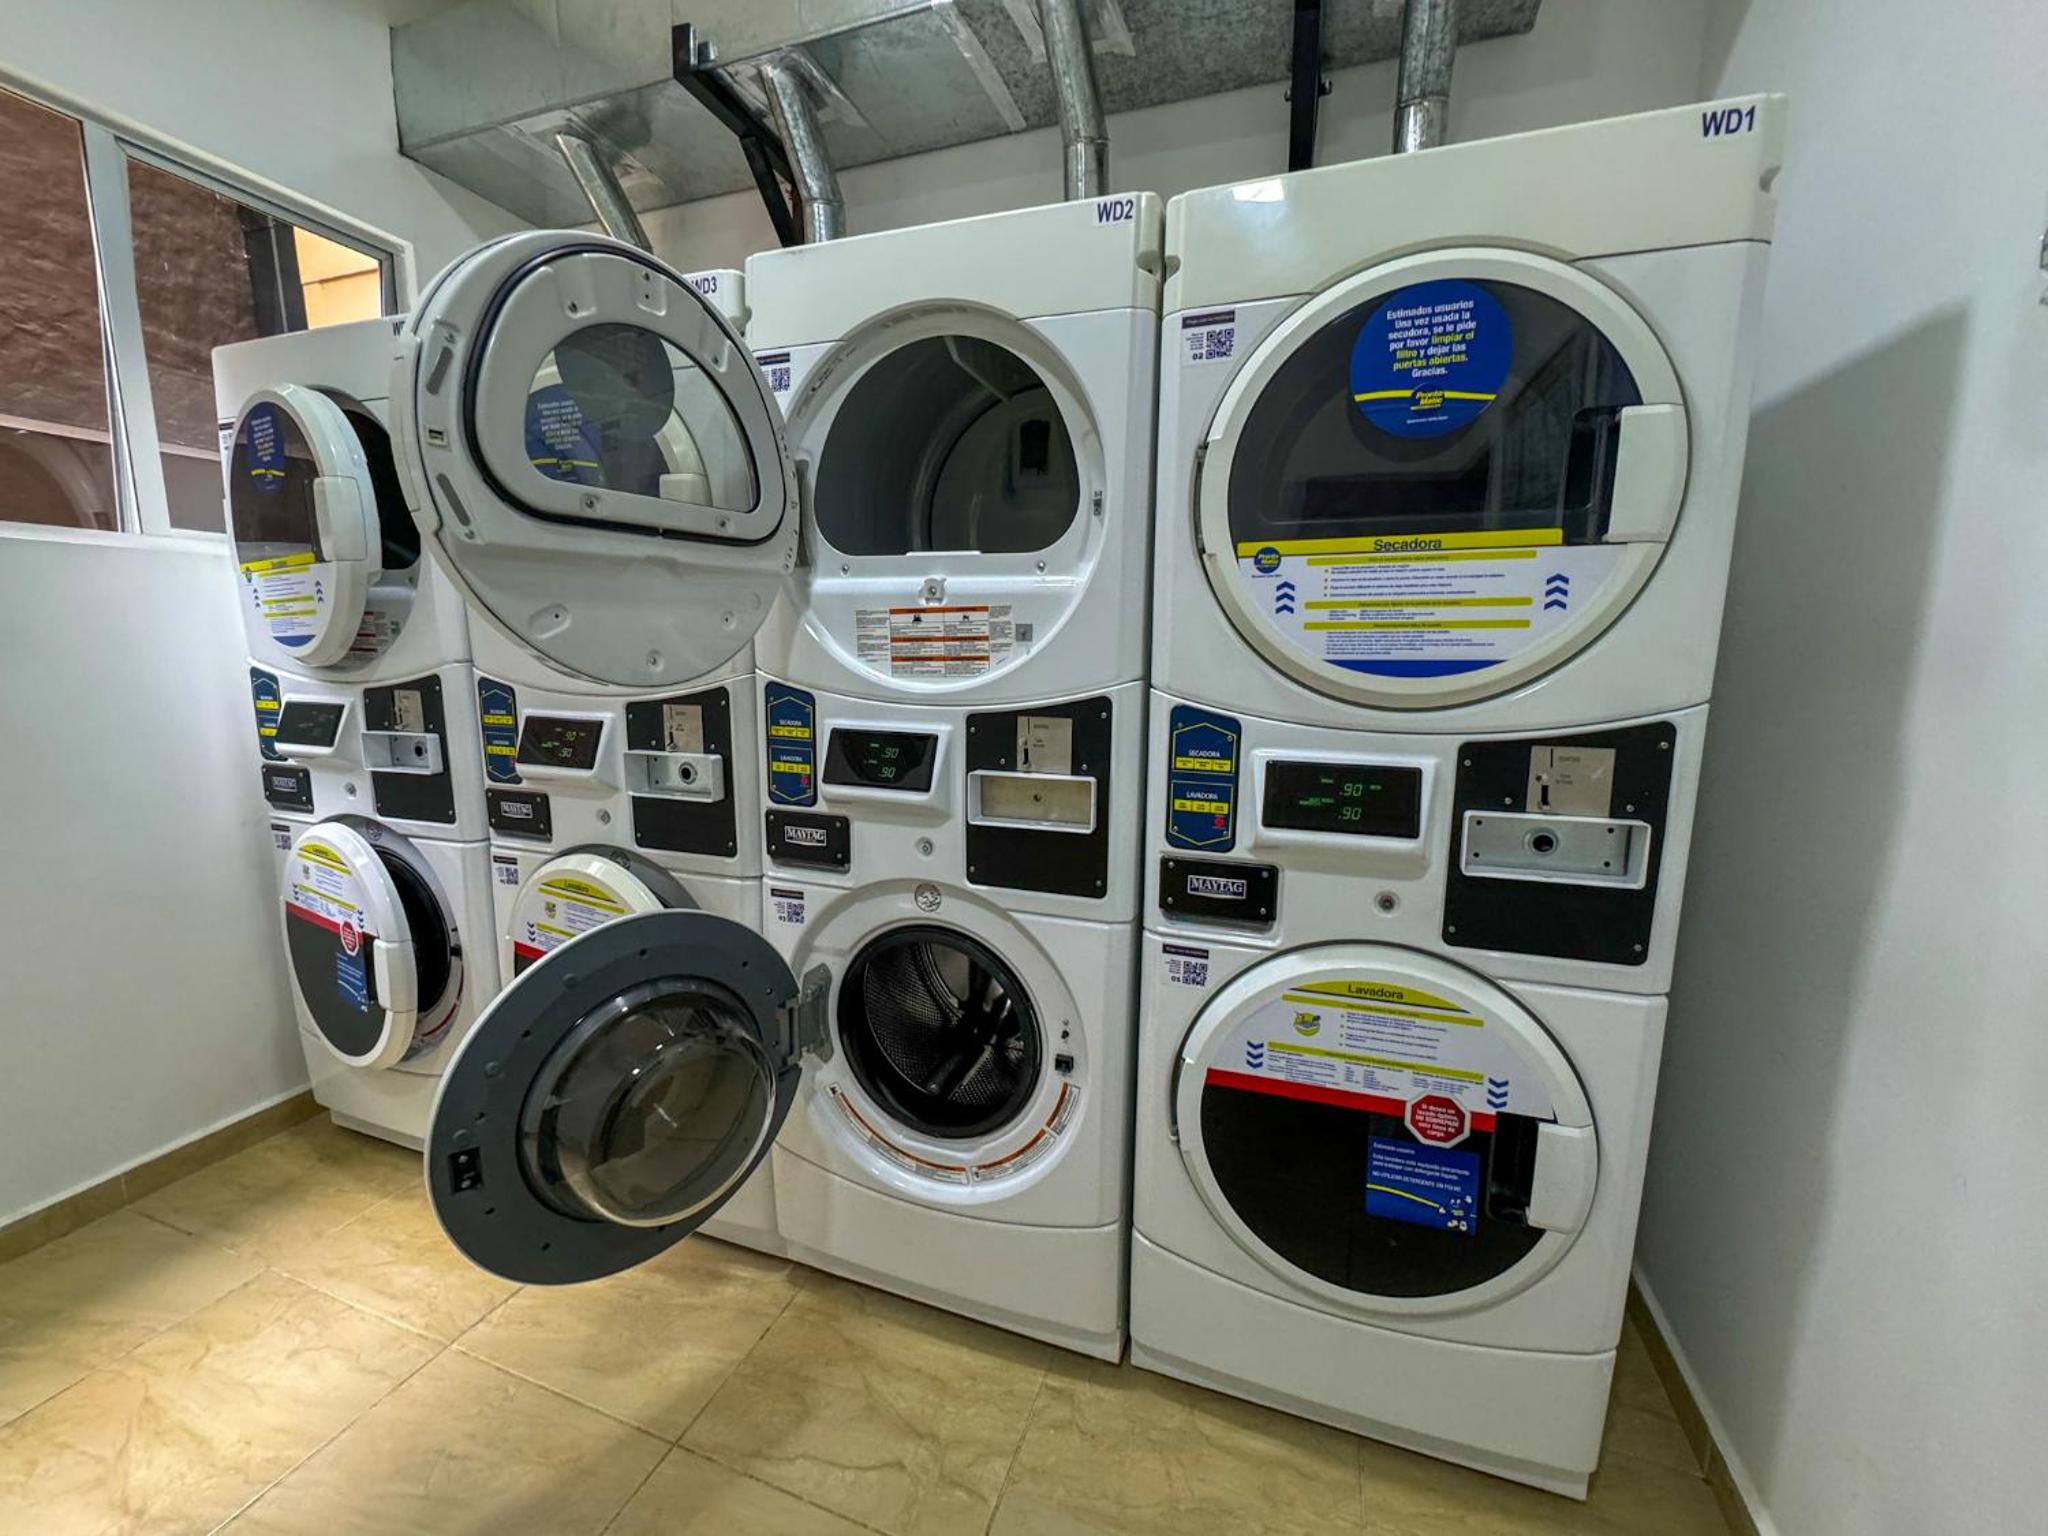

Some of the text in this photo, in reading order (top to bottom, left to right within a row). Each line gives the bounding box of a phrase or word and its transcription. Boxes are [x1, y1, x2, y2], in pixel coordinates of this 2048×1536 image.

[1702, 105, 1756, 138] WD1
[1097, 199, 1134, 223] WD2
[1387, 300, 1474, 320] Estimados usuarios
[1414, 317, 1430, 326] vez
[1431, 312, 1459, 323] usada
[1461, 310, 1471, 320] la
[1433, 325, 1444, 334] se
[1456, 320, 1477, 333] pide
[1389, 341, 1405, 352] por
[1406, 337, 1429, 348] favor
[1465, 331, 1475, 340] el
[1419, 348, 1426, 358] y
[1426, 344, 1450, 356] dejar
[1452, 343, 1467, 352] las
[1393, 359, 1427, 372] puertas
[1411, 367, 1449, 378] Gracias.
[1374, 538, 1442, 551] Secadora
[1189, 749, 1220, 758] SECADORA
[1186, 791, 1219, 800] LAVADORA
[1191, 878, 1243, 892] MAYTAG
[1348, 983, 1404, 1000] Lavadora
